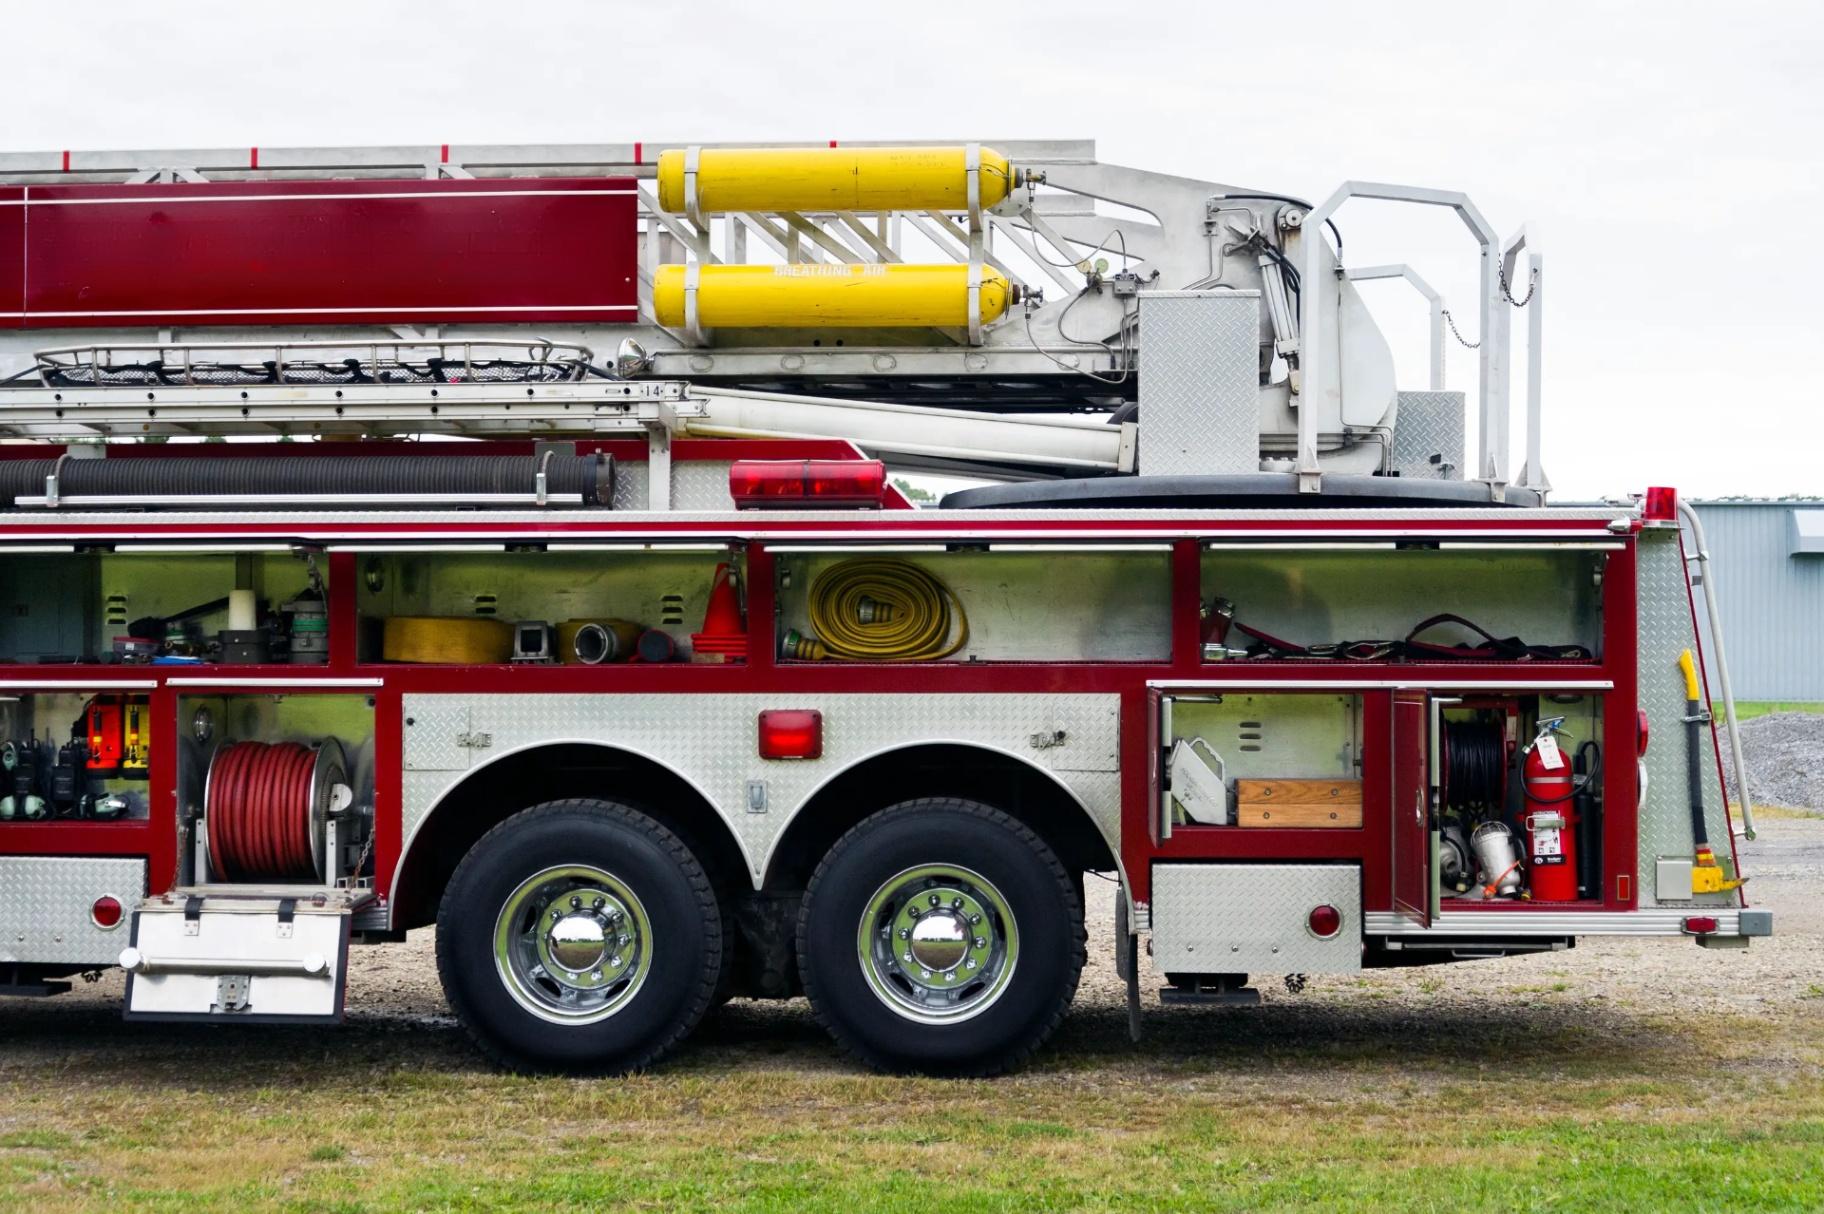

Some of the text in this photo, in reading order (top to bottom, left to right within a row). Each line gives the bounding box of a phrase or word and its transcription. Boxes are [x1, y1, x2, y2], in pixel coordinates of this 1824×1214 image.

[774, 264, 887, 277] BREATHING AIR
[646, 385, 660, 397] 14
